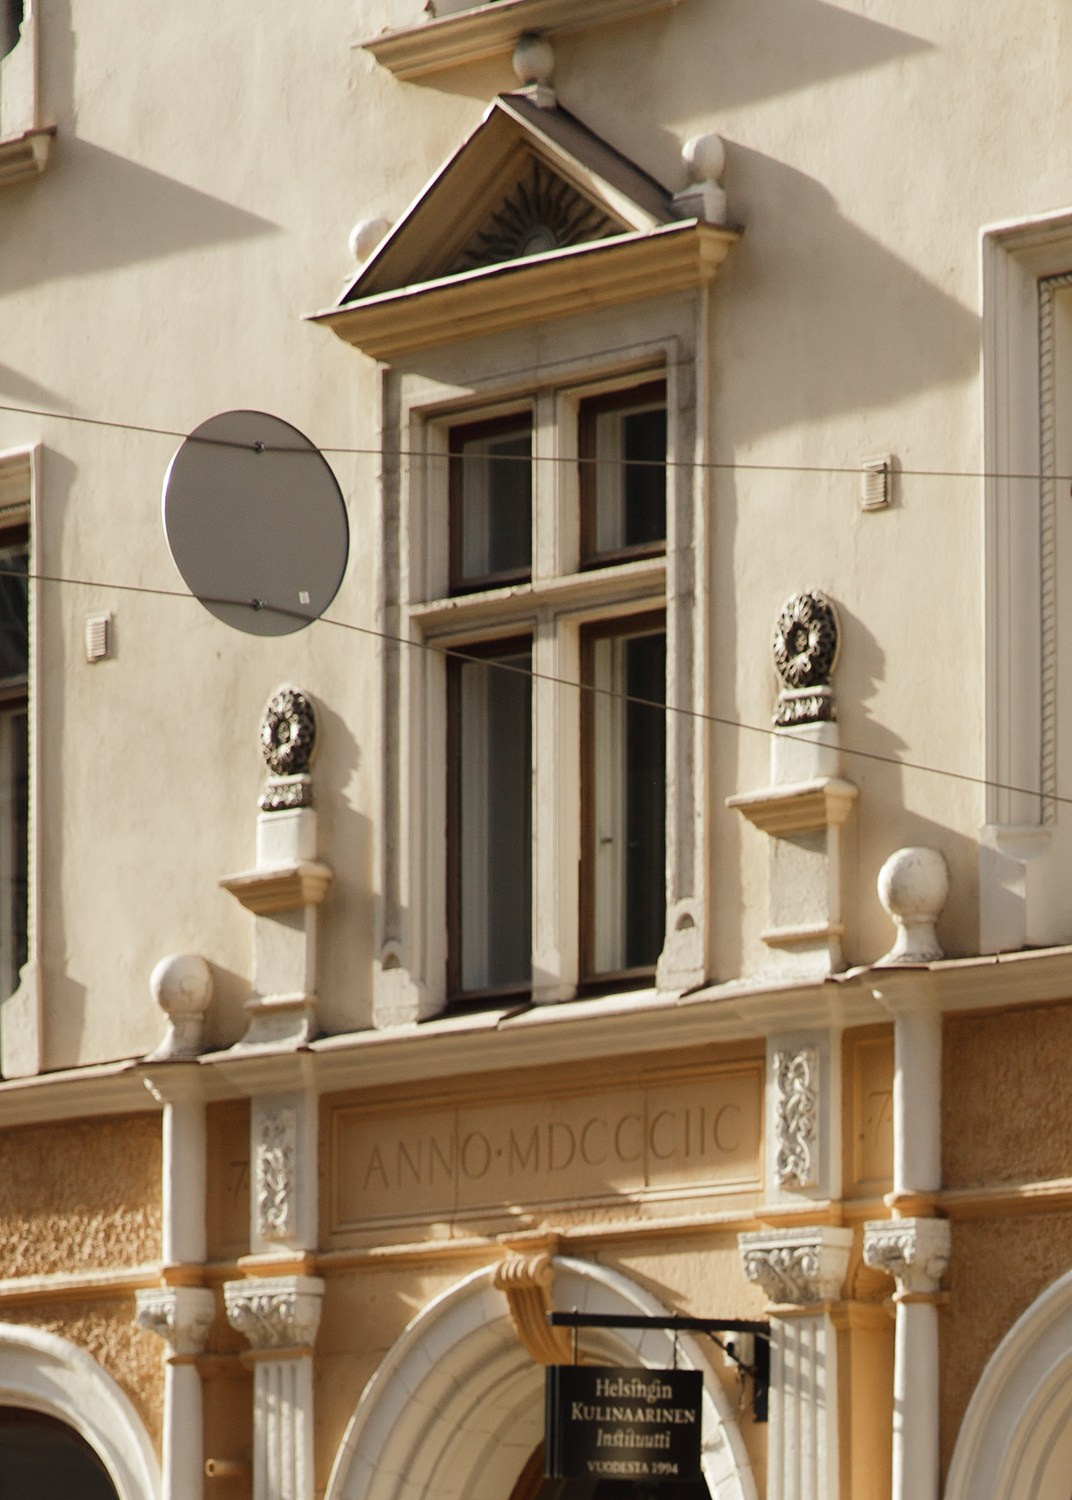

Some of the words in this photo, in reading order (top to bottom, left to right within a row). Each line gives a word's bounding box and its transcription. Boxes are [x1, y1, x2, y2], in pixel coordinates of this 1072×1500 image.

[595, 1377, 673, 1403] Helsingin
[571, 1402, 695, 1424] KULINAARINEN
[596, 1428, 671, 1449] Instituutti
[587, 1461, 648, 1474] VUODESTA
[651, 1461, 678, 1475] 1994
